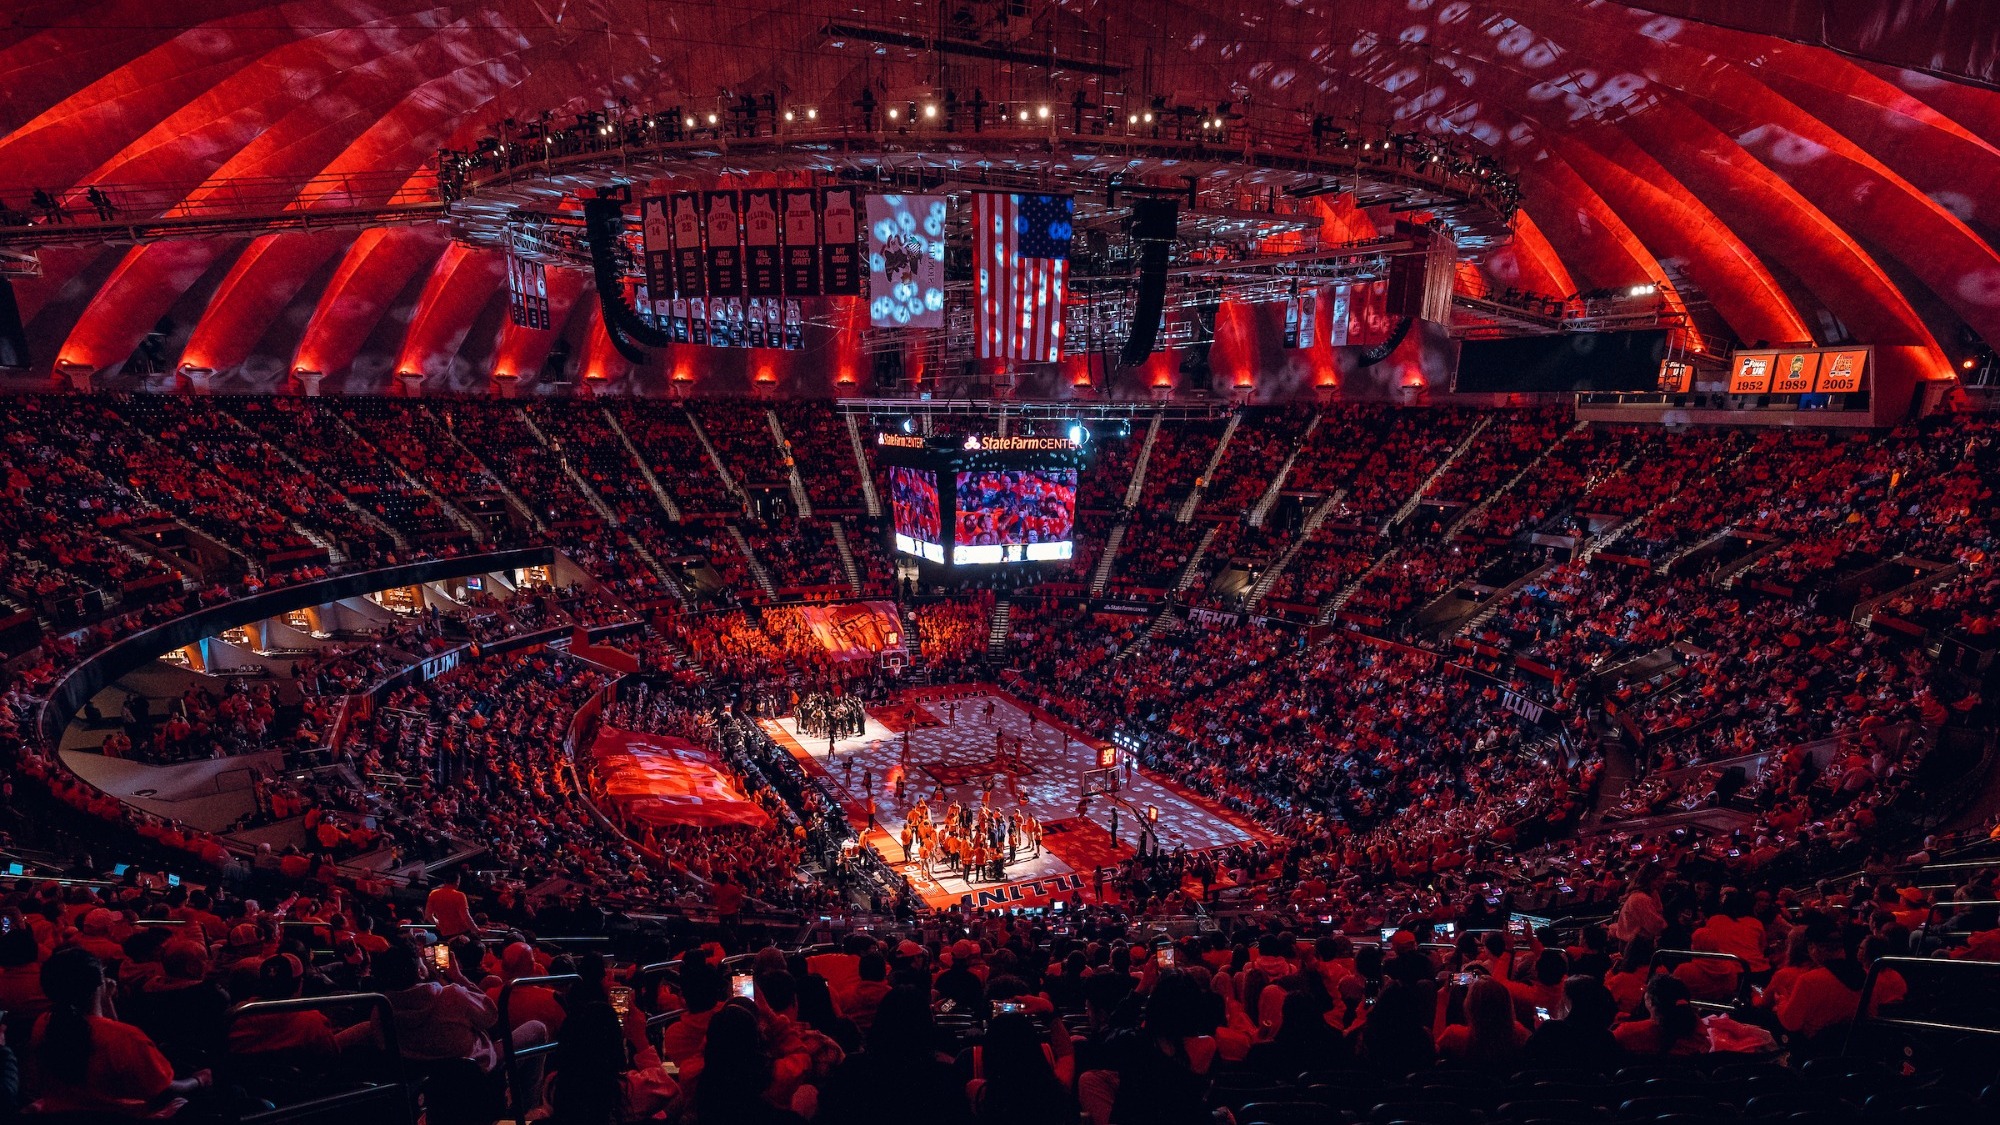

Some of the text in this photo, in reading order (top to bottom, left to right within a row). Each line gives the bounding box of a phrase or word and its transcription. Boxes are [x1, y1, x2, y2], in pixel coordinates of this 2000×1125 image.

[716, 221, 728, 231] 47
[797, 219, 804, 231] 1
[837, 221, 843, 234] 1
[652, 226, 661, 236] 14
[1750, 359, 1767, 367] FINAL
[1736, 380, 1764, 391] 1952
[1779, 380, 1807, 391] 1989
[1822, 379, 1854, 390] 2005
[422, 650, 460, 682] ILLINI
[1502, 691, 1544, 724] ILLINI
[960, 873, 1087, 909] ILLINI
